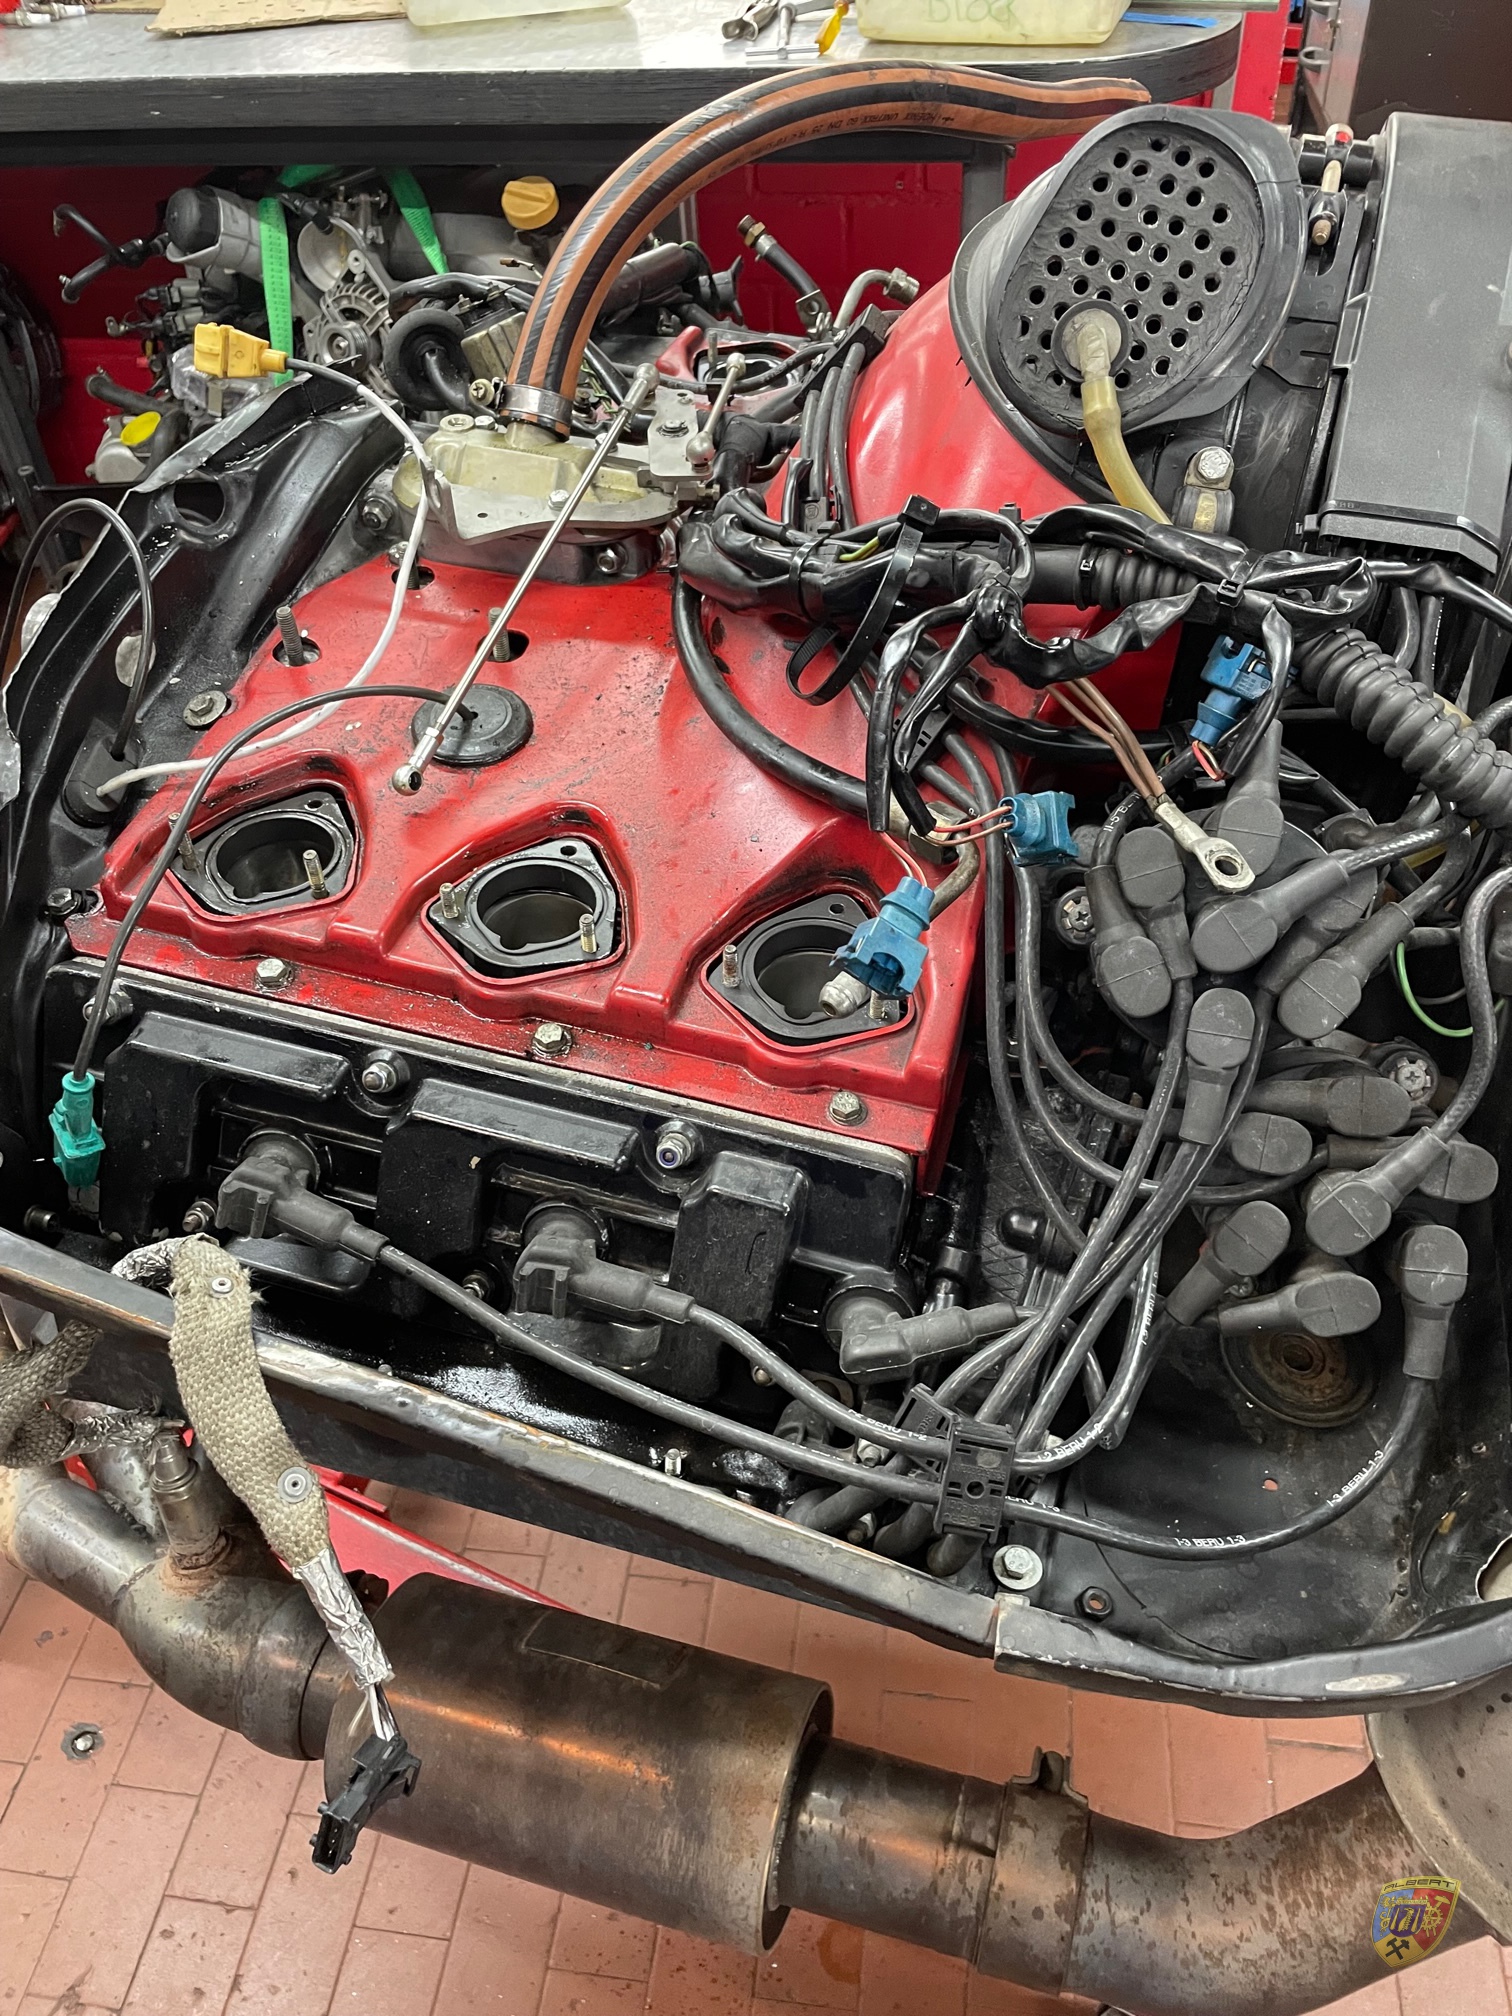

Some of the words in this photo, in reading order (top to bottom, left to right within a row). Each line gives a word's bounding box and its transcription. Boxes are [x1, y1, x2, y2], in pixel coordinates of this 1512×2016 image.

[1053, 1436, 1087, 1460] BERU
[1340, 1467, 1369, 1496] BERU
[1191, 1537, 1225, 1548] BERU
